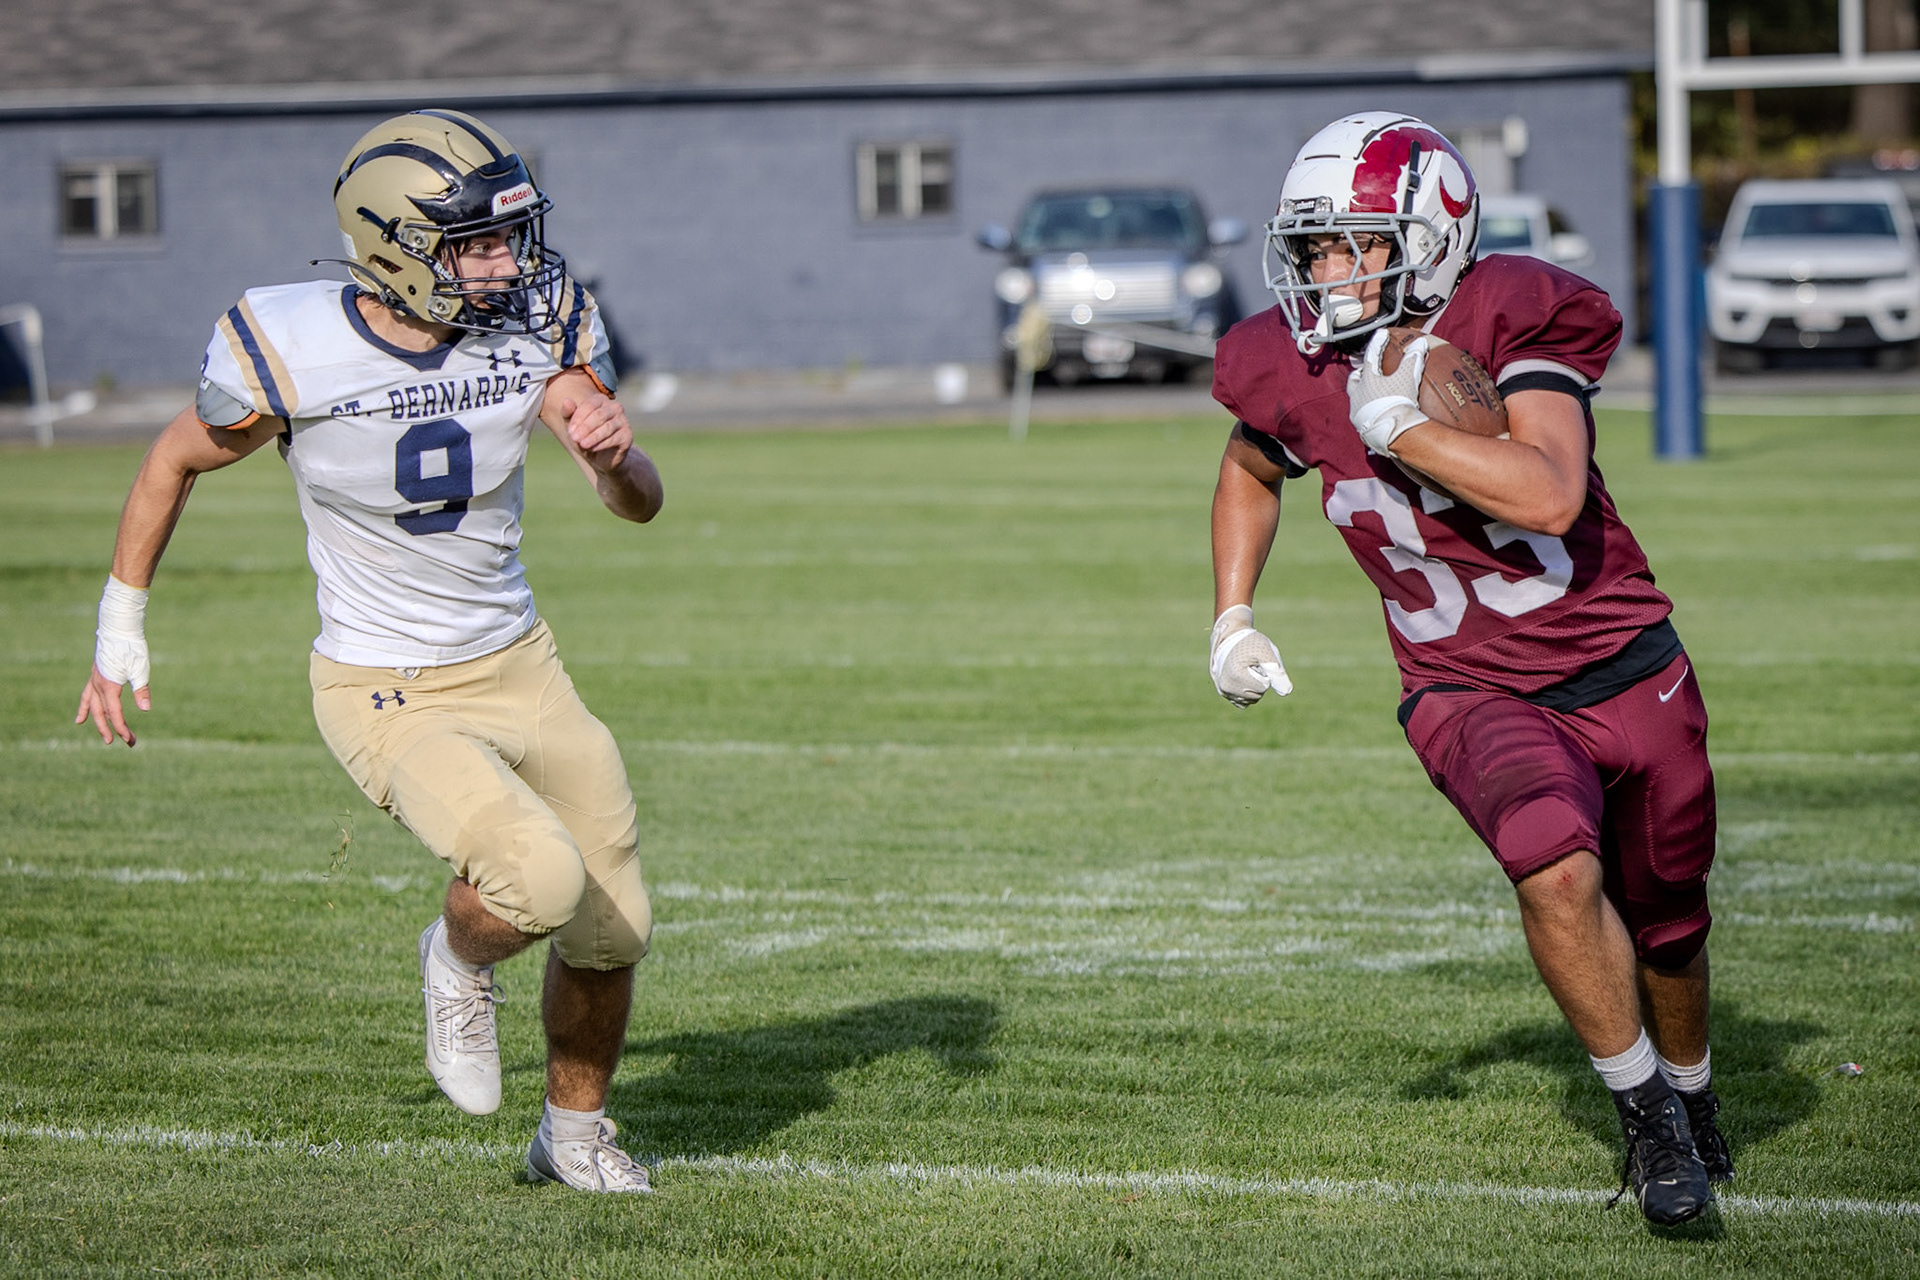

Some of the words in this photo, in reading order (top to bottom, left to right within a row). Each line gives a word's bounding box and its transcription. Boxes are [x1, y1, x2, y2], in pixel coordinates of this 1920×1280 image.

[500, 186, 533, 206] Riddell
[388, 372, 531, 419] BERNARD'S
[1444, 382, 1466, 408] NCAA
[1453, 370, 1484, 407] GST
[394, 418, 473, 536] 9
